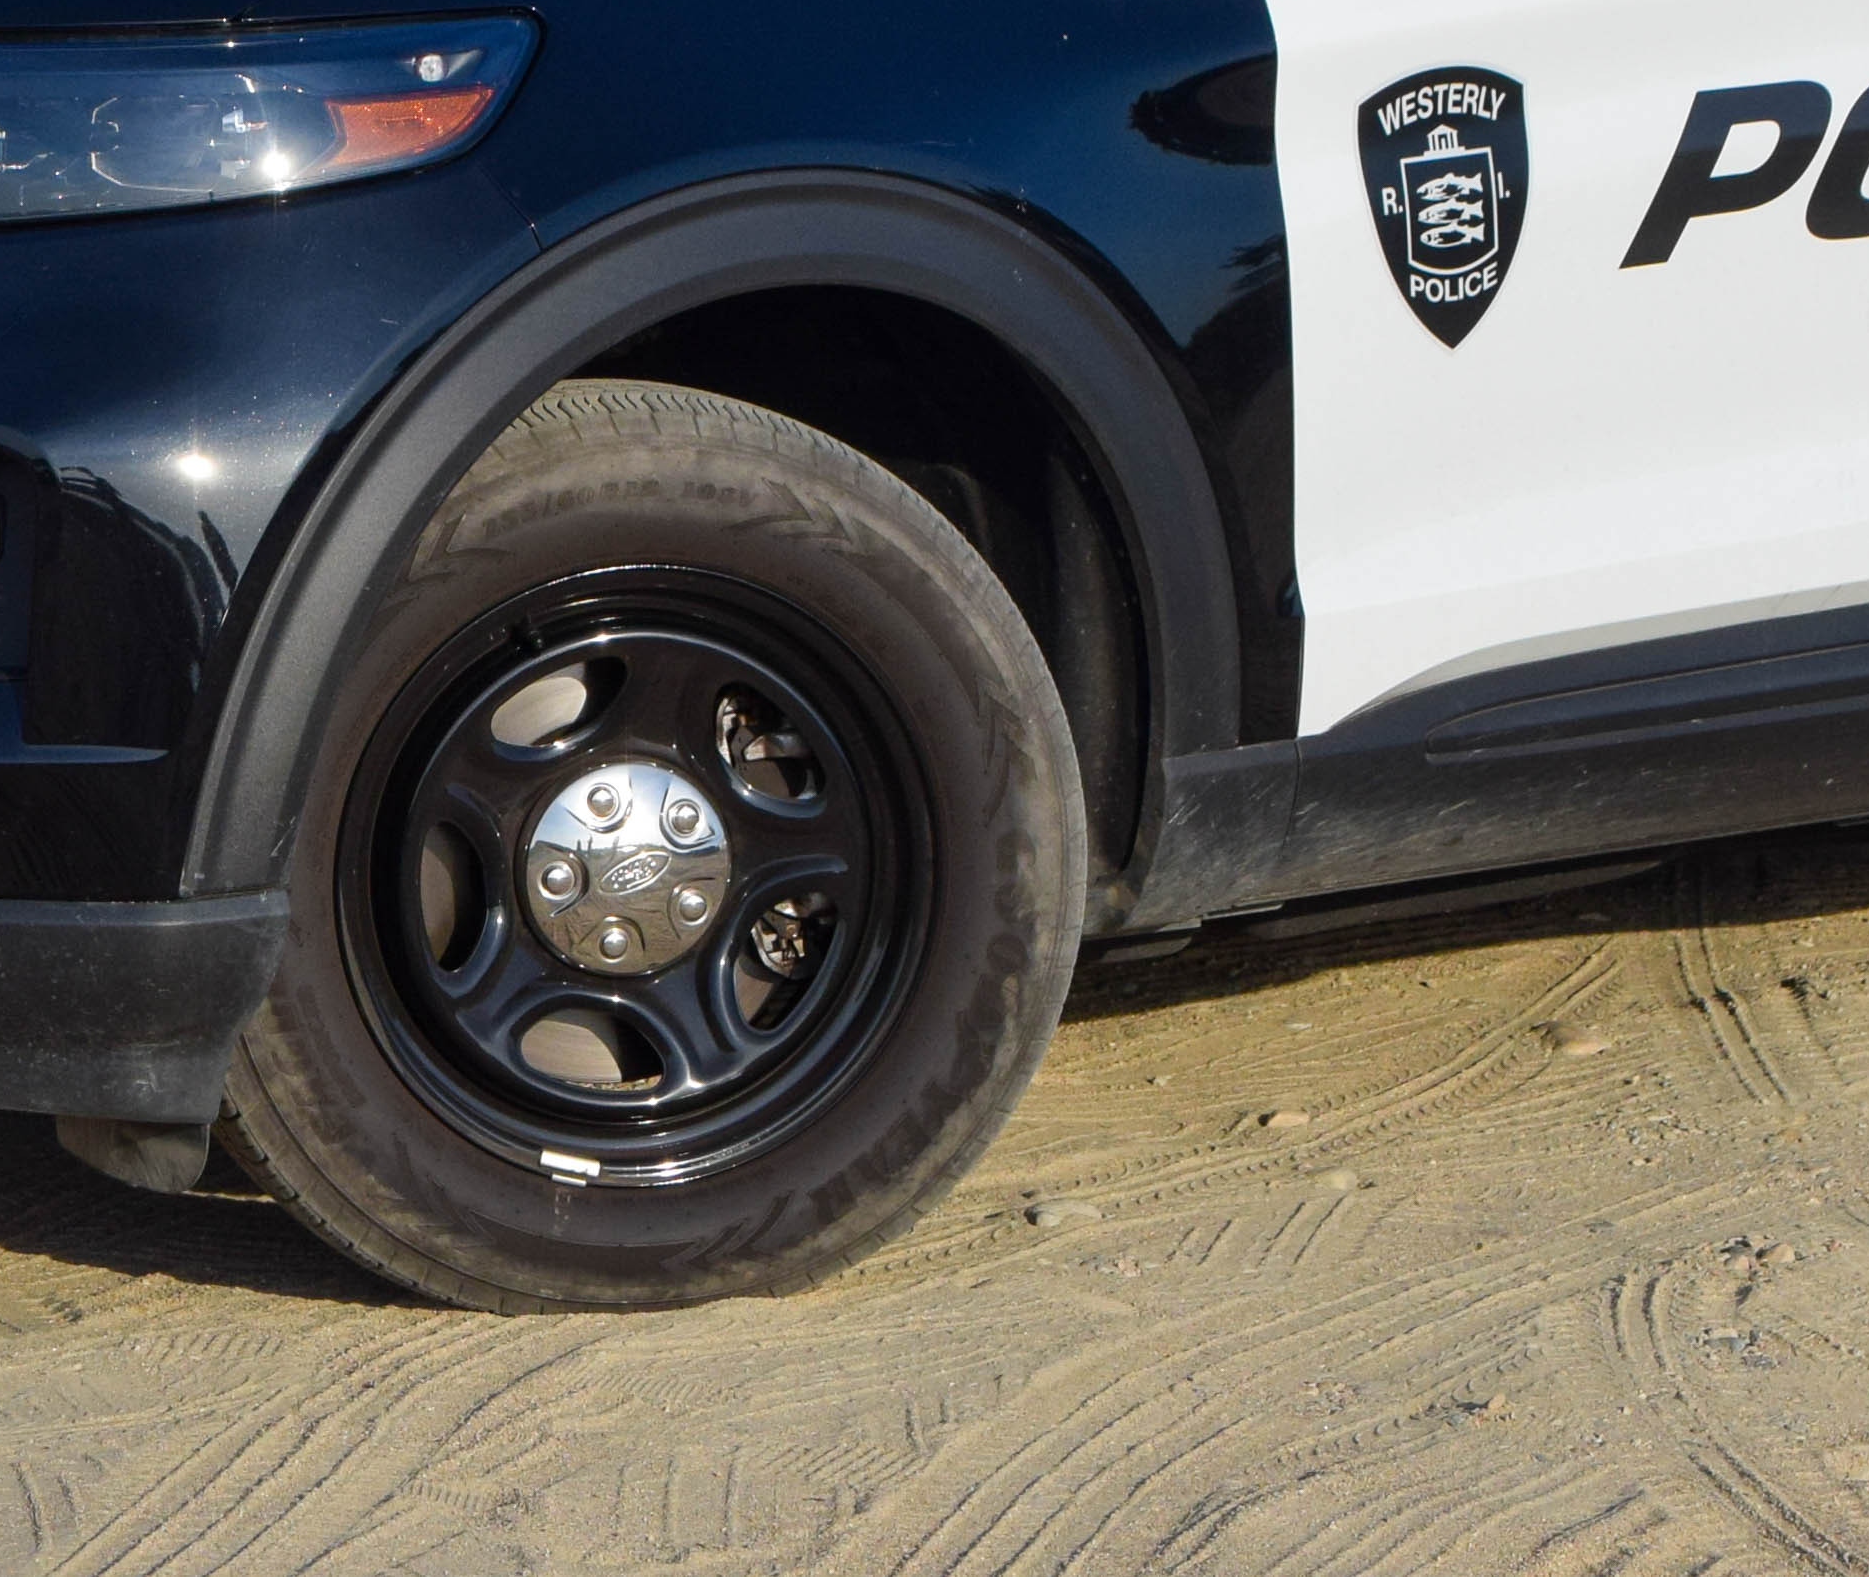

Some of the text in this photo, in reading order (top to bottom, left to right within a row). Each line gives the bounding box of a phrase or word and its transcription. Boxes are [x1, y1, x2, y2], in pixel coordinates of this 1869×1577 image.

[1378, 83, 1506, 136] WESTERLY
[1382, 171, 1511, 216] R. I.
[1410, 262, 1498, 302] POLICE
